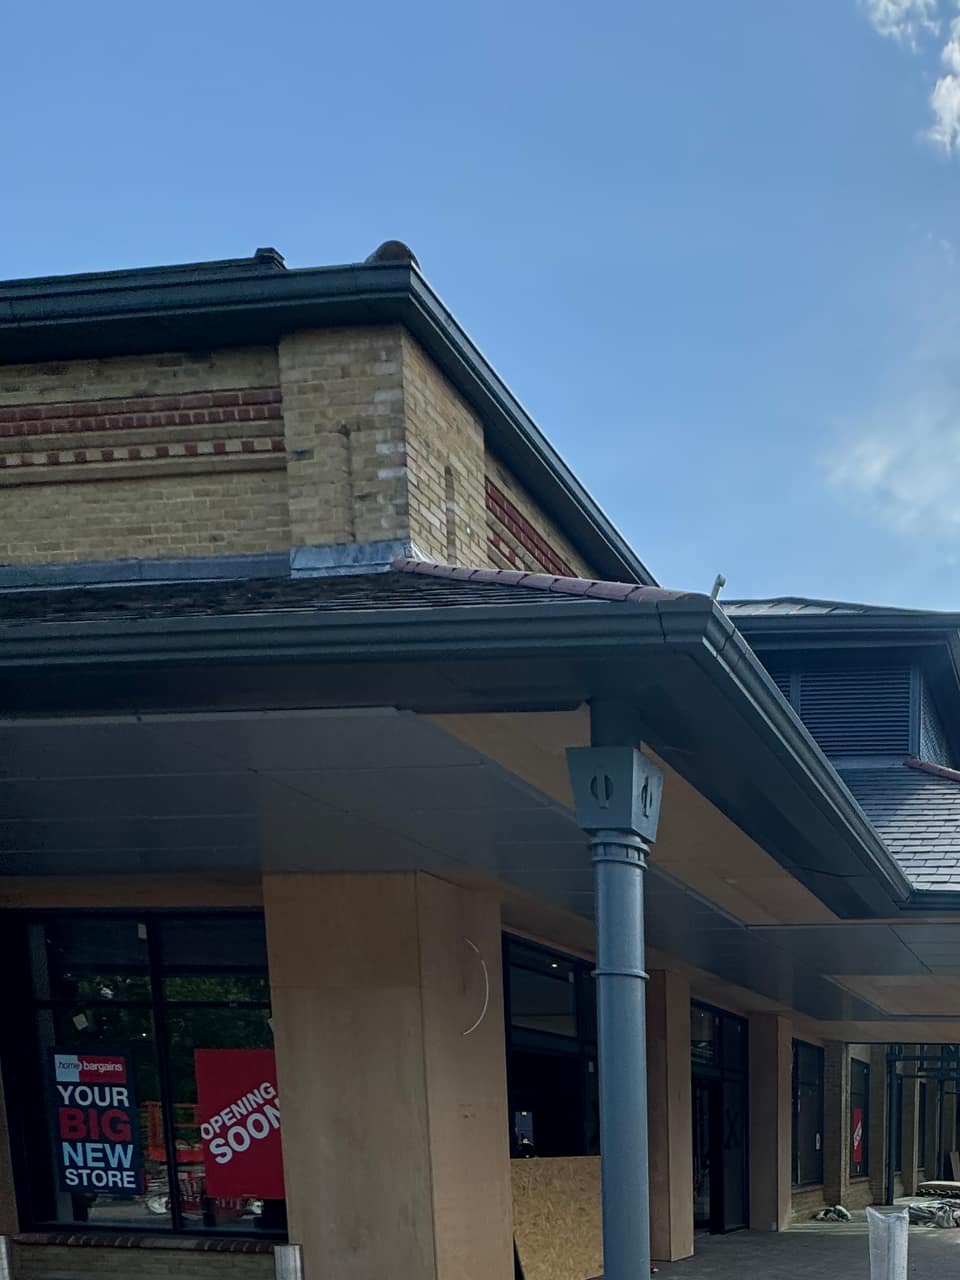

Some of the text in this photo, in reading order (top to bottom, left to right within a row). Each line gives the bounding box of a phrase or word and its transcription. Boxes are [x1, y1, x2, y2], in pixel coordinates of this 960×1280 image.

[58, 1060, 123, 1072] home bargains
[56, 1085, 129, 1107] YOUR
[200, 1082, 277, 1140] OPENING
[60, 1107, 132, 1141] BIG
[62, 1142, 133, 1168] NEW
[65, 1169, 136, 1188] STORE
